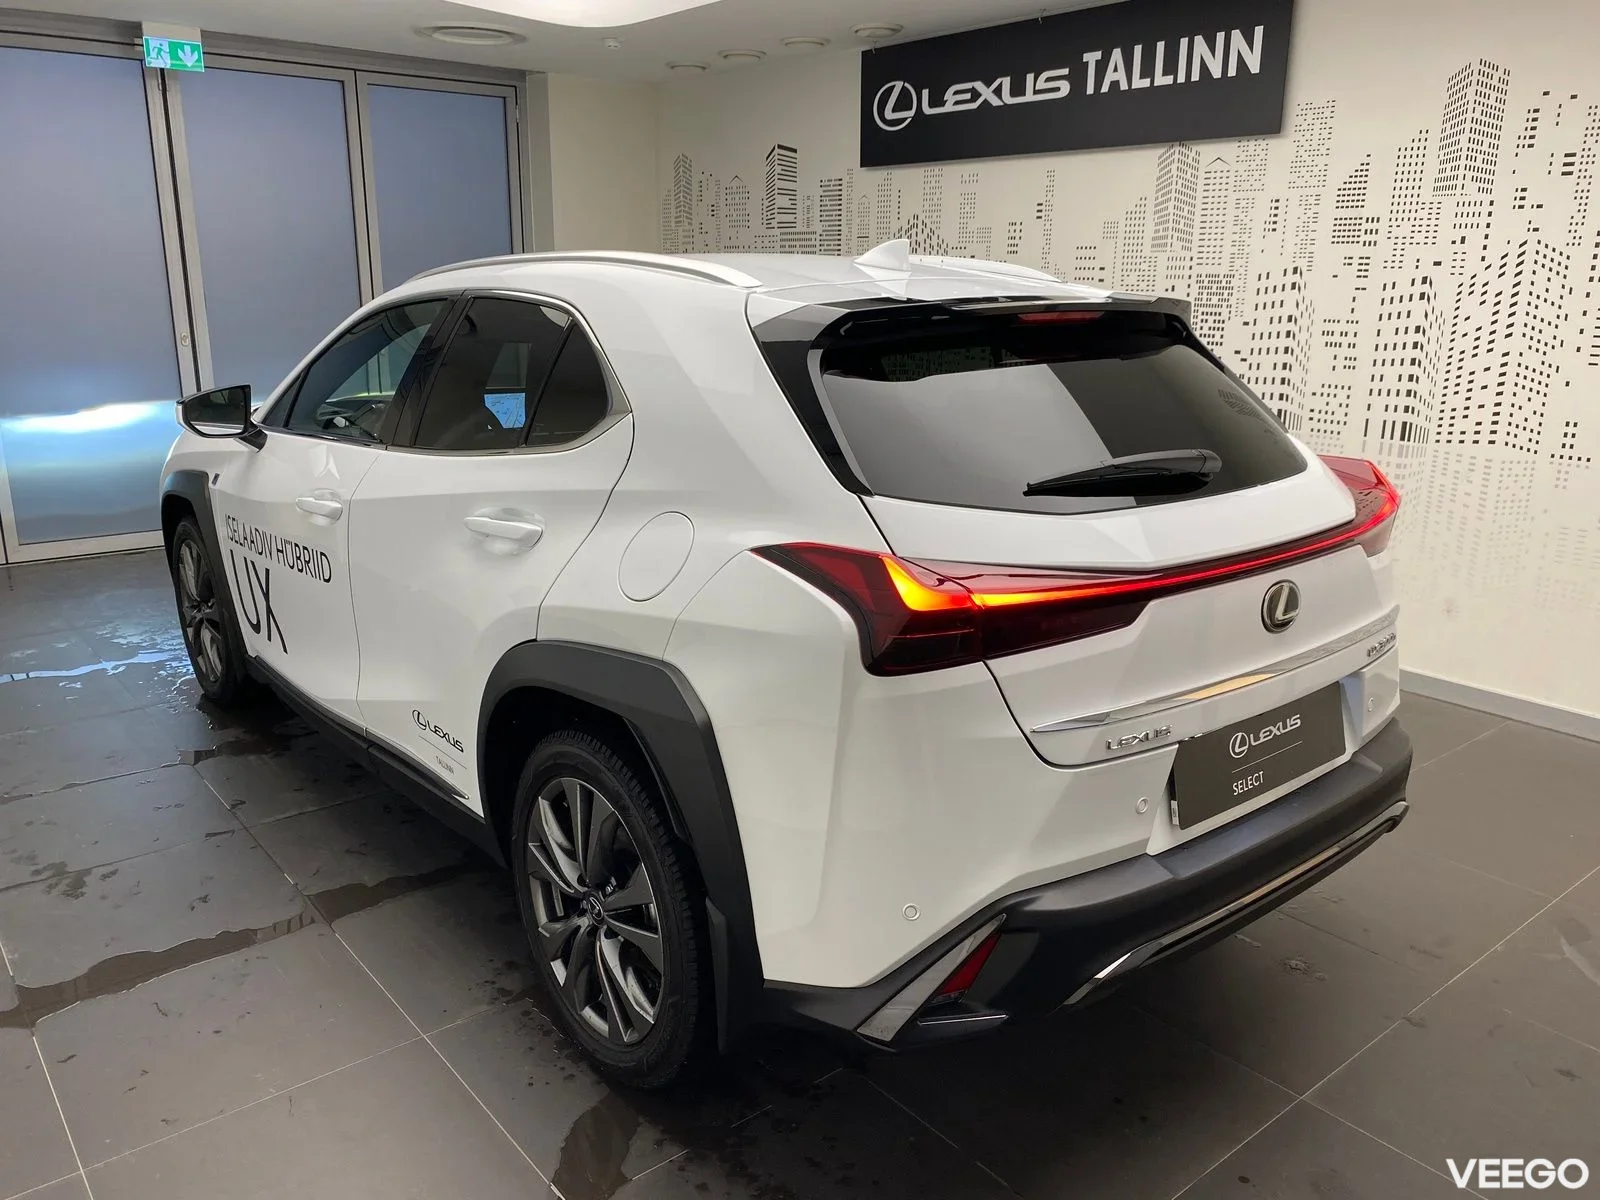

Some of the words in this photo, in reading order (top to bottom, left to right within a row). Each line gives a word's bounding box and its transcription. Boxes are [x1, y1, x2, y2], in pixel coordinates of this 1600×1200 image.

[921, 68, 1070, 115] LEXUS
[1083, 25, 1264, 95] TALLINN
[225, 513, 273, 561] ISELAADIV
[229, 549, 288, 655] UX
[426, 720, 464, 753] LEXUS
[1105, 725, 1171, 750] LEXUS
[1249, 714, 1301, 746] LEXUS
[1232, 770, 1264, 796] SELECT
